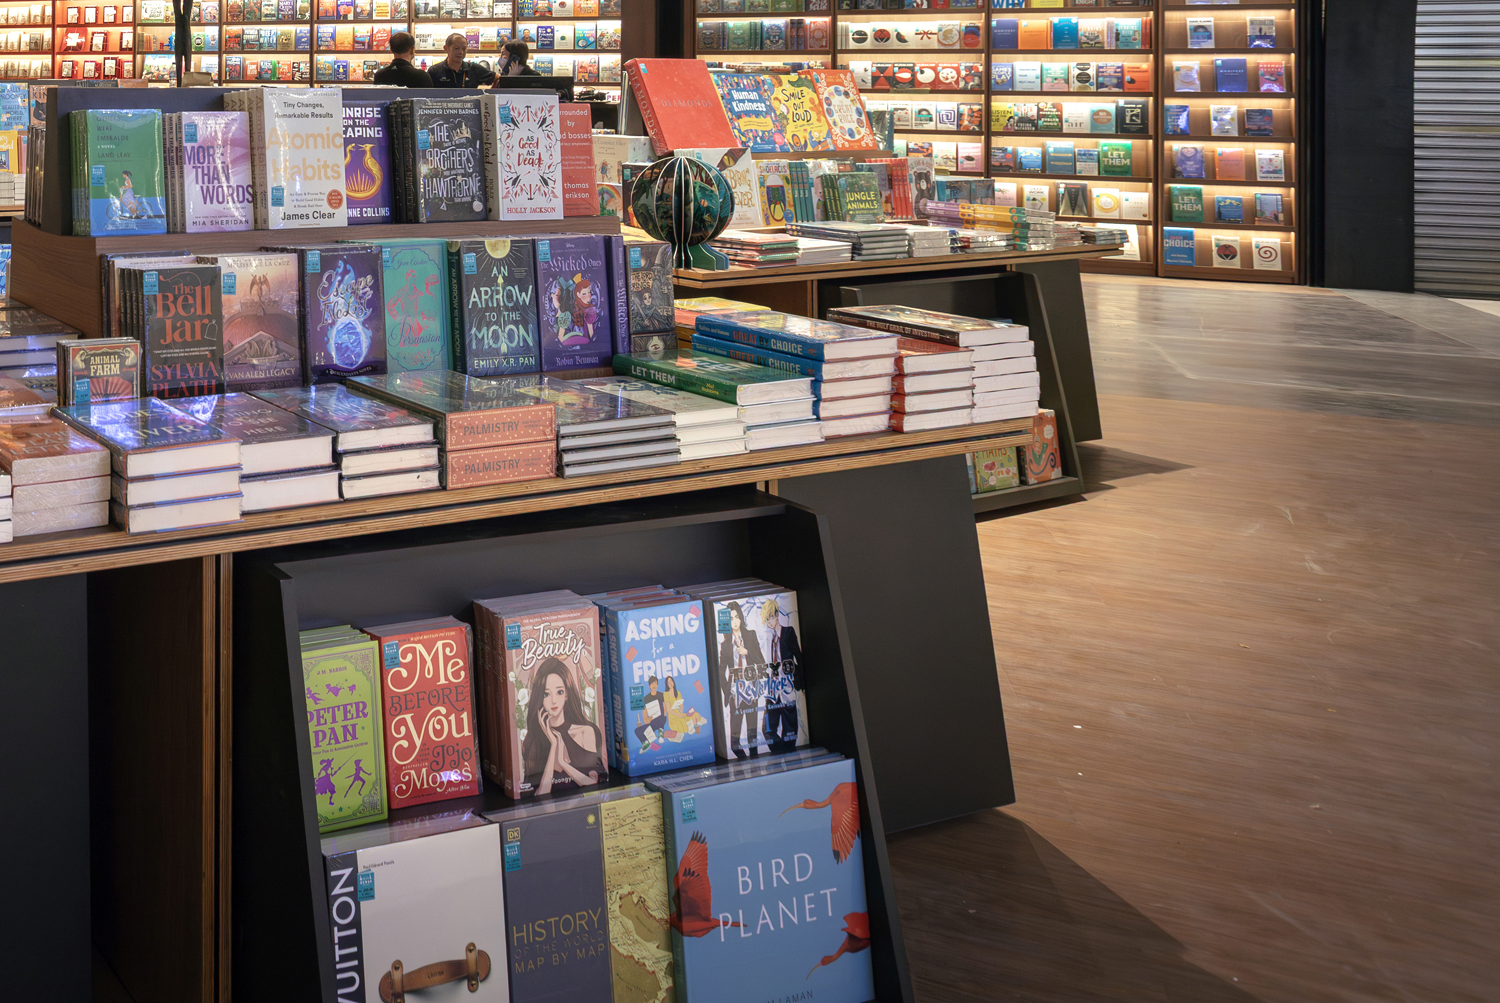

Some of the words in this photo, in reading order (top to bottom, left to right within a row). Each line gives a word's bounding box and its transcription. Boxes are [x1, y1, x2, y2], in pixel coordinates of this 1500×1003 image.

[661, 99, 714, 108] DIAMONDS
[732, 89, 759, 101] Human
[733, 100, 767, 113] Kindness
[792, 110, 812, 123] LOUD
[266, 126, 343, 152] Atomic
[184, 146, 226, 165] MORE
[426, 148, 475, 169] BROTHERS
[1102, 157, 1131, 166] THEM
[192, 166, 230, 184] THAN
[272, 158, 341, 183] Habits
[200, 184, 254, 205] WORDS
[846, 191, 875, 202] JUNGLE
[1178, 196, 1196, 205] LET
[529, 206, 556, 214] JACKSON
[847, 200, 878, 209] ANIMALS
[1173, 203, 1202, 212] THEM
[208, 218, 249, 226] SHERIDAN
[281, 210, 310, 221] James
[312, 210, 336, 220] Clear
[1164, 239, 1194, 248] CHOICE
[491, 265, 508, 277] AN
[548, 258, 588, 272] Wicked
[173, 283, 195, 294] The
[317, 270, 374, 300] Escape
[156, 285, 213, 319] Bell
[468, 285, 533, 309] ARROW
[485, 312, 498, 322] TO
[504, 310, 521, 321] THE
[160, 318, 210, 346] Jar
[465, 324, 534, 350] MOON
[732, 329, 758, 345] GREAT
[758, 334, 769, 347] BY
[770, 338, 803, 356] CHOICE
[90, 356, 120, 365] ANIMAL
[90, 364, 120, 376] FARM
[474, 358, 499, 368] EMILY
[519, 356, 535, 366] PAN
[555, 356, 574, 366] Robin
[151, 361, 218, 381] SYLVIA
[228, 372, 245, 380] VAN
[266, 368, 295, 377] LEGACY
[631, 365, 648, 376] LET
[650, 367, 676, 385] THEM
[153, 380, 216, 398] PLATH
[463, 421, 520, 436] PALMISTRY
[464, 458, 520, 474] PALMISTRY
[533, 622, 566, 644] True
[625, 613, 699, 642] ASKING
[521, 634, 586, 670] Beauty
[651, 639, 663, 658] for
[388, 639, 466, 692] Me
[632, 654, 700, 684] FRIEND
[729, 659, 795, 683] TOKYO
[389, 684, 466, 716] BEFORE
[307, 700, 369, 727] PETER
[313, 723, 358, 748] PAN
[430, 743, 472, 772] Jojo
[395, 762, 472, 799] Moyes
[736, 851, 814, 895] BIRD
[717, 887, 839, 943] PLANET
[513, 907, 603, 948] HISTORY
[514, 957, 542, 974] MAP
[551, 952, 570, 966] BY
[574, 943, 606, 960] MAP
